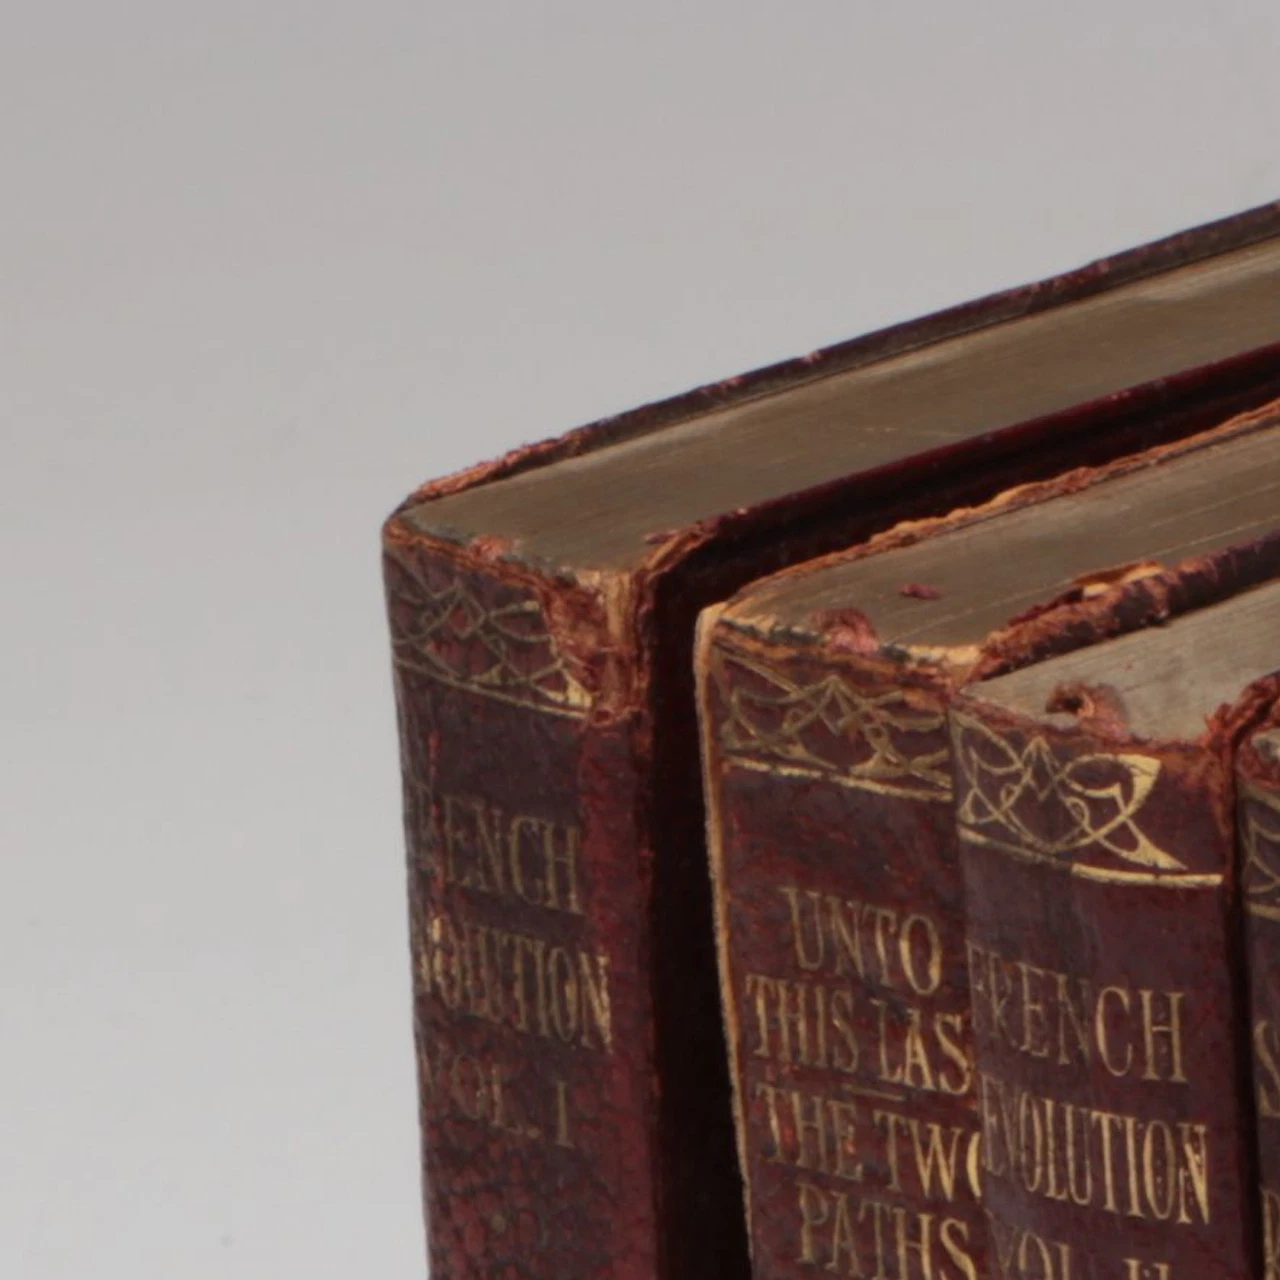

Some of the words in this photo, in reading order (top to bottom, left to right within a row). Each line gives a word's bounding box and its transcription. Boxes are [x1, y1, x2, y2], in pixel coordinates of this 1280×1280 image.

[777, 884, 943, 996] UNTO
[744, 972, 859, 1073] THIS
[869, 997, 975, 1096] LAS
[757, 1081, 864, 1182] THE
